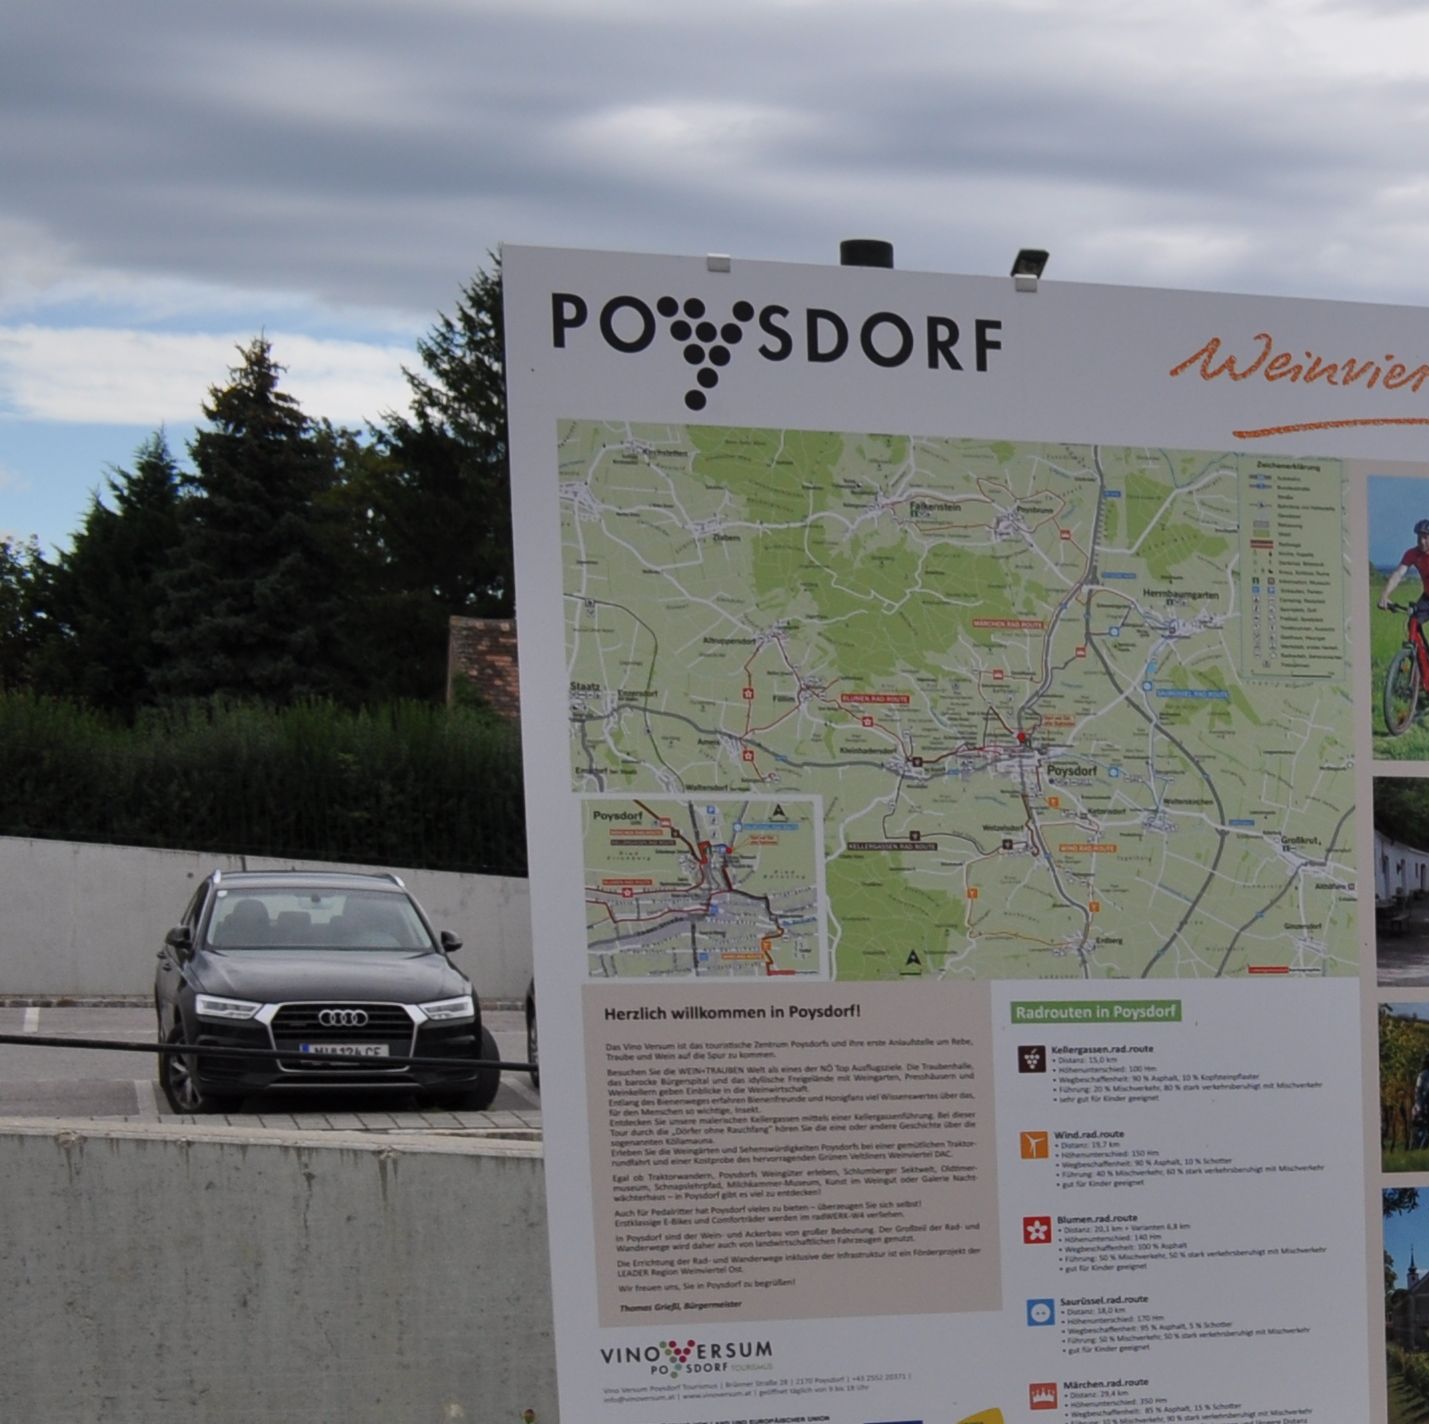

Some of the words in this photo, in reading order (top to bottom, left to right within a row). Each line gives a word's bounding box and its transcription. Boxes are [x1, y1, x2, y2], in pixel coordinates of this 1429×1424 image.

[1257, 461, 1321, 473] Zeichenerklärung
[910, 502, 961, 512] Falkenstein
[1143, 588, 1220, 601] Herrnbaumgarten
[570, 682, 600, 692] Staatz
[872, 695, 886, 703] RAD
[887, 695, 909, 703] ROUTE
[1047, 765, 1098, 778] Poysdorf
[593, 811, 643, 823] Poysdorf
[605, 1007, 667, 1021] Herzlich
[671, 1006, 766, 1020] willkommen
[770, 1006, 784, 1019] in
[789, 1004, 861, 1020] Poysdorf!
[1016, 1005, 1092, 1019] Radrouten
[1096, 1006, 1110, 1018] in
[1113, 1004, 1176, 1020] Poysdorf
[606, 1043, 621, 1051] Das
[705, 1041, 751, 1049] touristische
[889, 1038, 934, 1046] Anlaufstelle
[1054, 1131, 1125, 1140] Wind.rad.route
[1057, 1215, 1138, 1225] Blumen.rad.route
[706, 1281, 741, 1290] Poysdorf
[754, 1279, 796, 1288] begrüßen!
[620, 1304, 652, 1312] Thomas
[683, 1301, 742, 1310] Bürgermeister
[1060, 1294, 1149, 1307] Saurüssel.rad.route
[1064, 1377, 1149, 1390] Märchen.rad.route
[749, 1416, 806, 1424] EUROPÄISCHER
